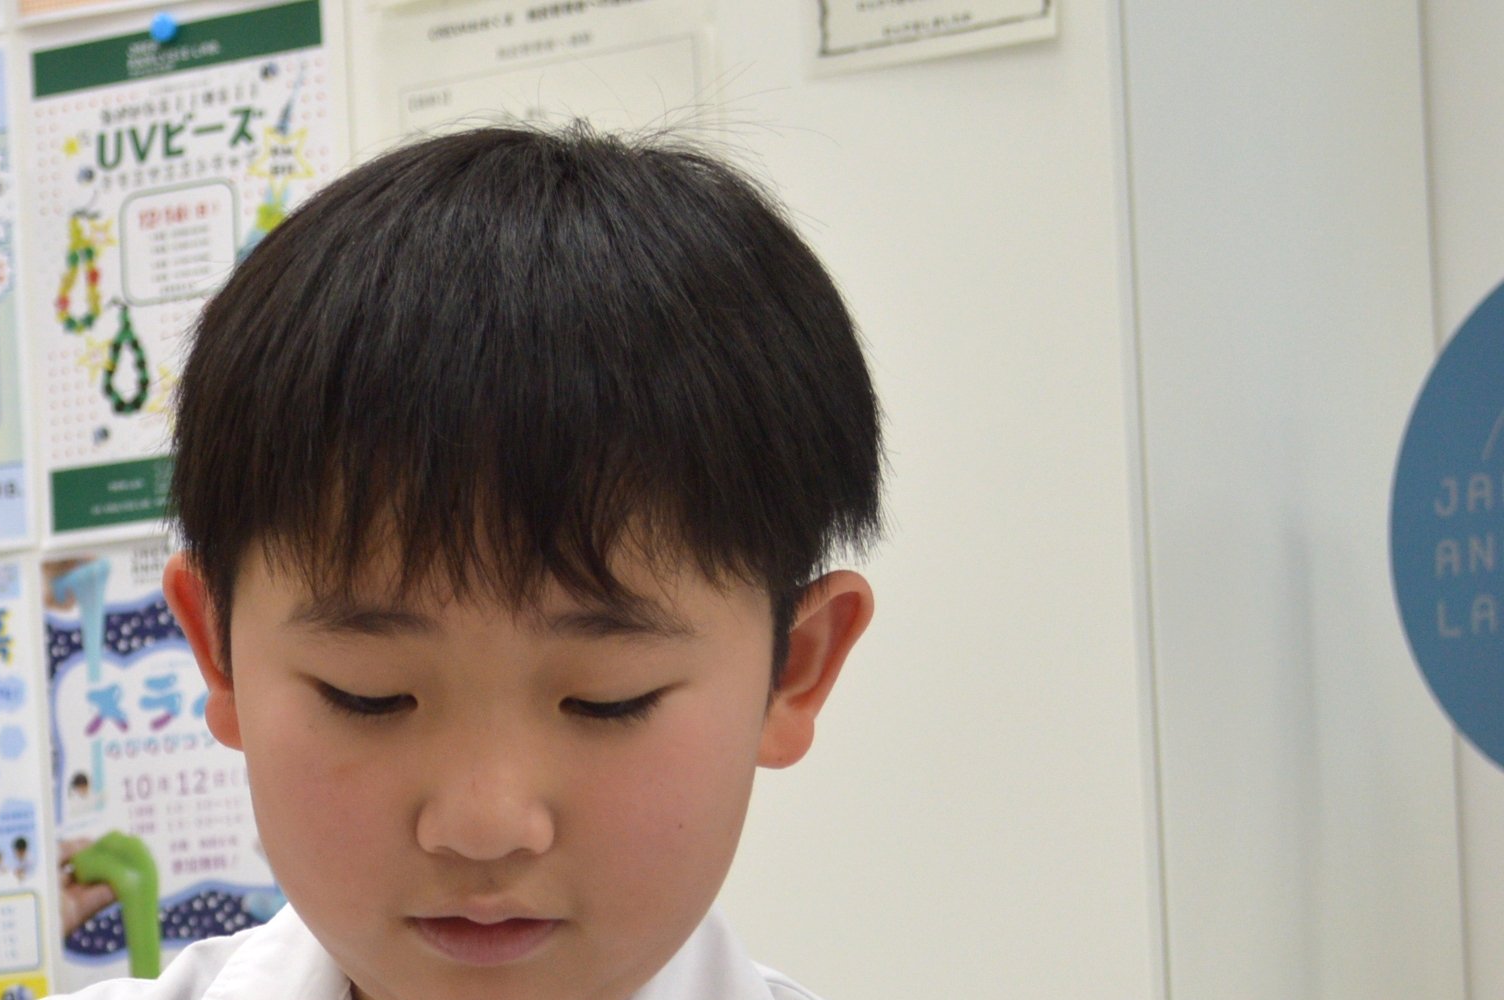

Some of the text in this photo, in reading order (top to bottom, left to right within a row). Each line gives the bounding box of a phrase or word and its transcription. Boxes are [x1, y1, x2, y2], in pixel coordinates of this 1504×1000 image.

[97, 105, 265, 170] UVビーズ
[1434, 473, 1504, 517] JA
